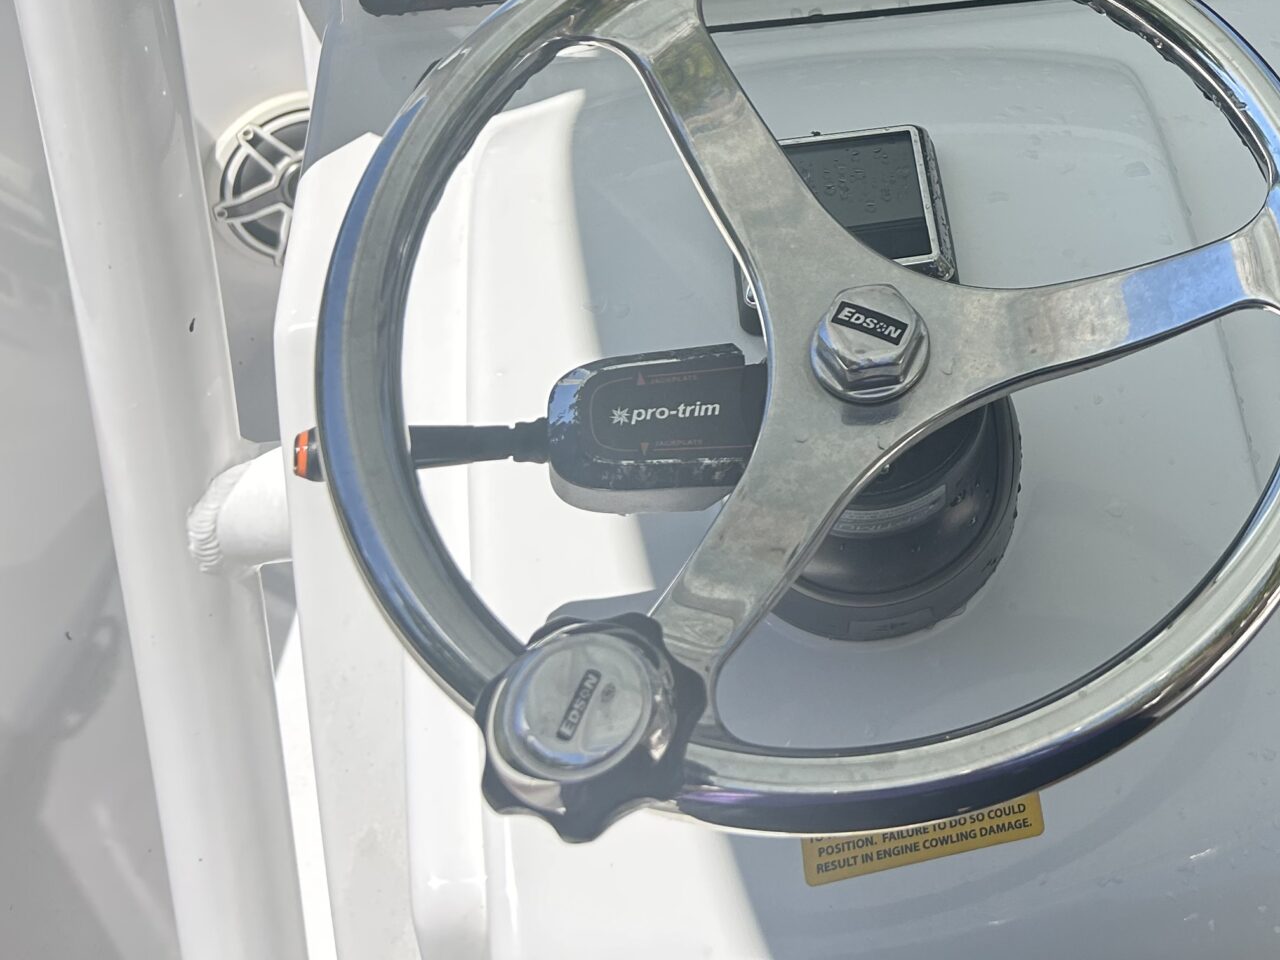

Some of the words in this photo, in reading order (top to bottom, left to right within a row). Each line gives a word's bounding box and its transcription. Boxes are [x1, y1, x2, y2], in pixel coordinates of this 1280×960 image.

[836, 306, 903, 339] EDSON
[631, 400, 721, 425] pro-trim
[560, 672, 598, 738] EDSON
[816, 854, 860, 875] RESULT
[861, 851, 874, 864] IN
[876, 841, 921, 860] ENGINE
[922, 829, 977, 850] COWLING
[979, 817, 1033, 837] DAMAGE.
[817, 835, 878, 857] POSITION.
[881, 825, 930, 843] FAILURE
[932, 821, 947, 832] TO
[948, 816, 967, 829] DO
[968, 812, 985, 824] SO
[987, 803, 1026, 820] COULD
